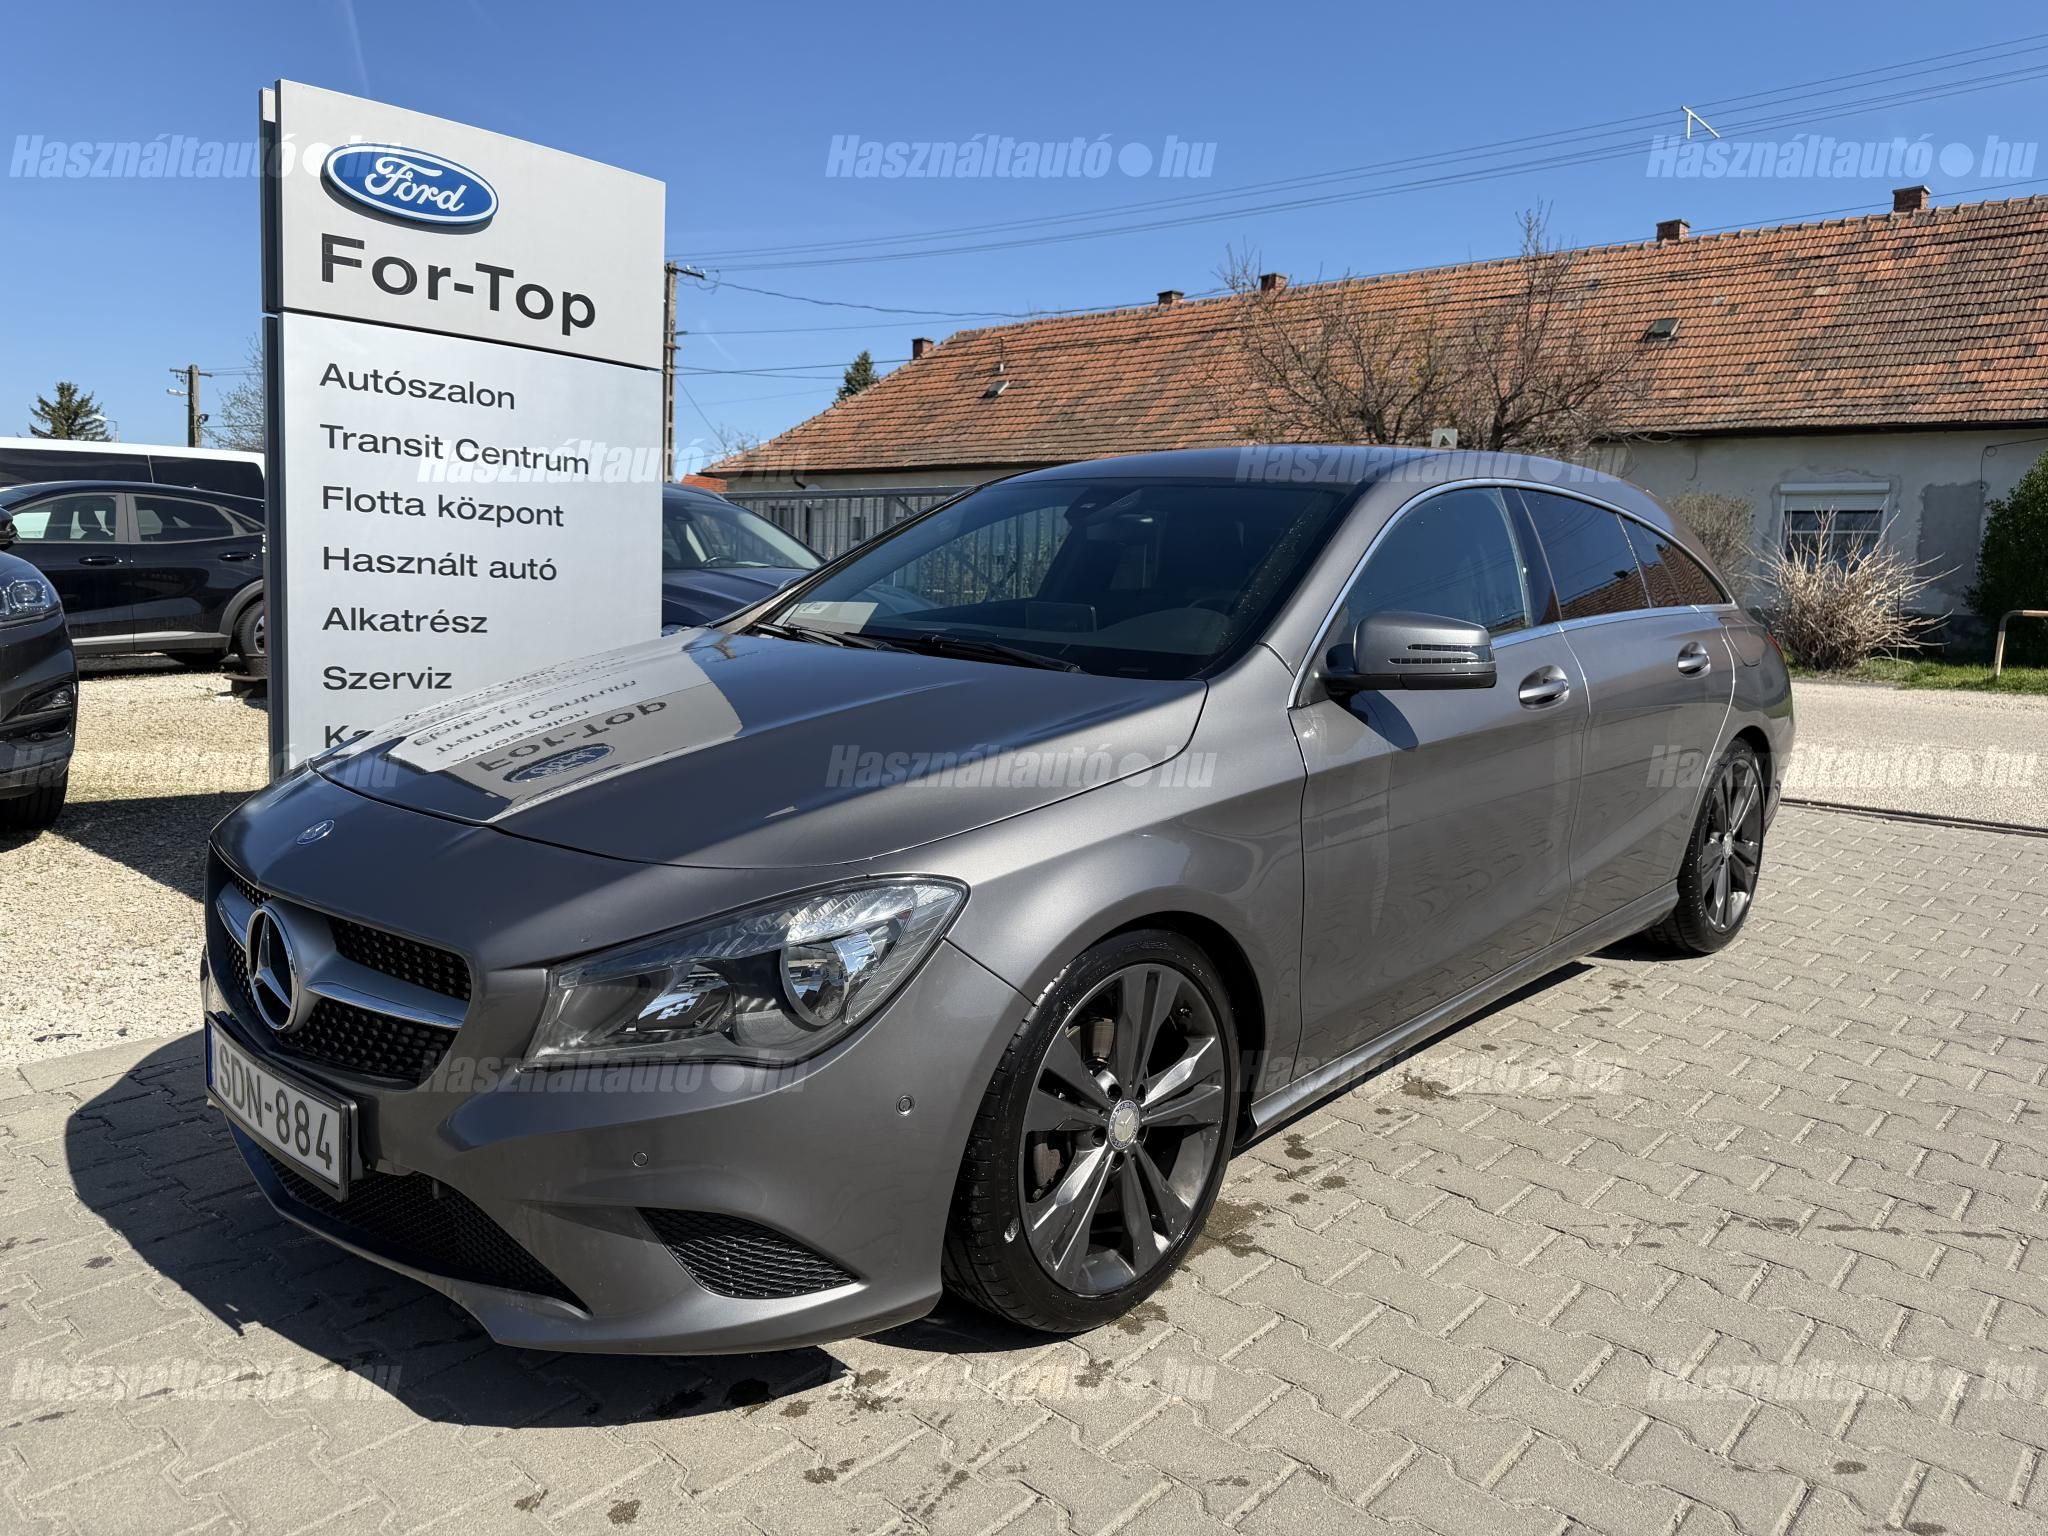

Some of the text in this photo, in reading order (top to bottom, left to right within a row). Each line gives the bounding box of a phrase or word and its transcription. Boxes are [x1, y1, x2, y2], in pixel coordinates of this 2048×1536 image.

[364, 156, 468, 212] Ford
[321, 233, 596, 337] For-Top
[319, 362, 515, 410] Autószalon
[319, 423, 590, 475] Transit Centrum
[322, 485, 565, 528] Flotta központ
[322, 546, 558, 581] Használt autó
[321, 606, 488, 634] Alkatrész
[322, 665, 453, 691] Szerviz
[209, 1043, 332, 1171] SDN-884
